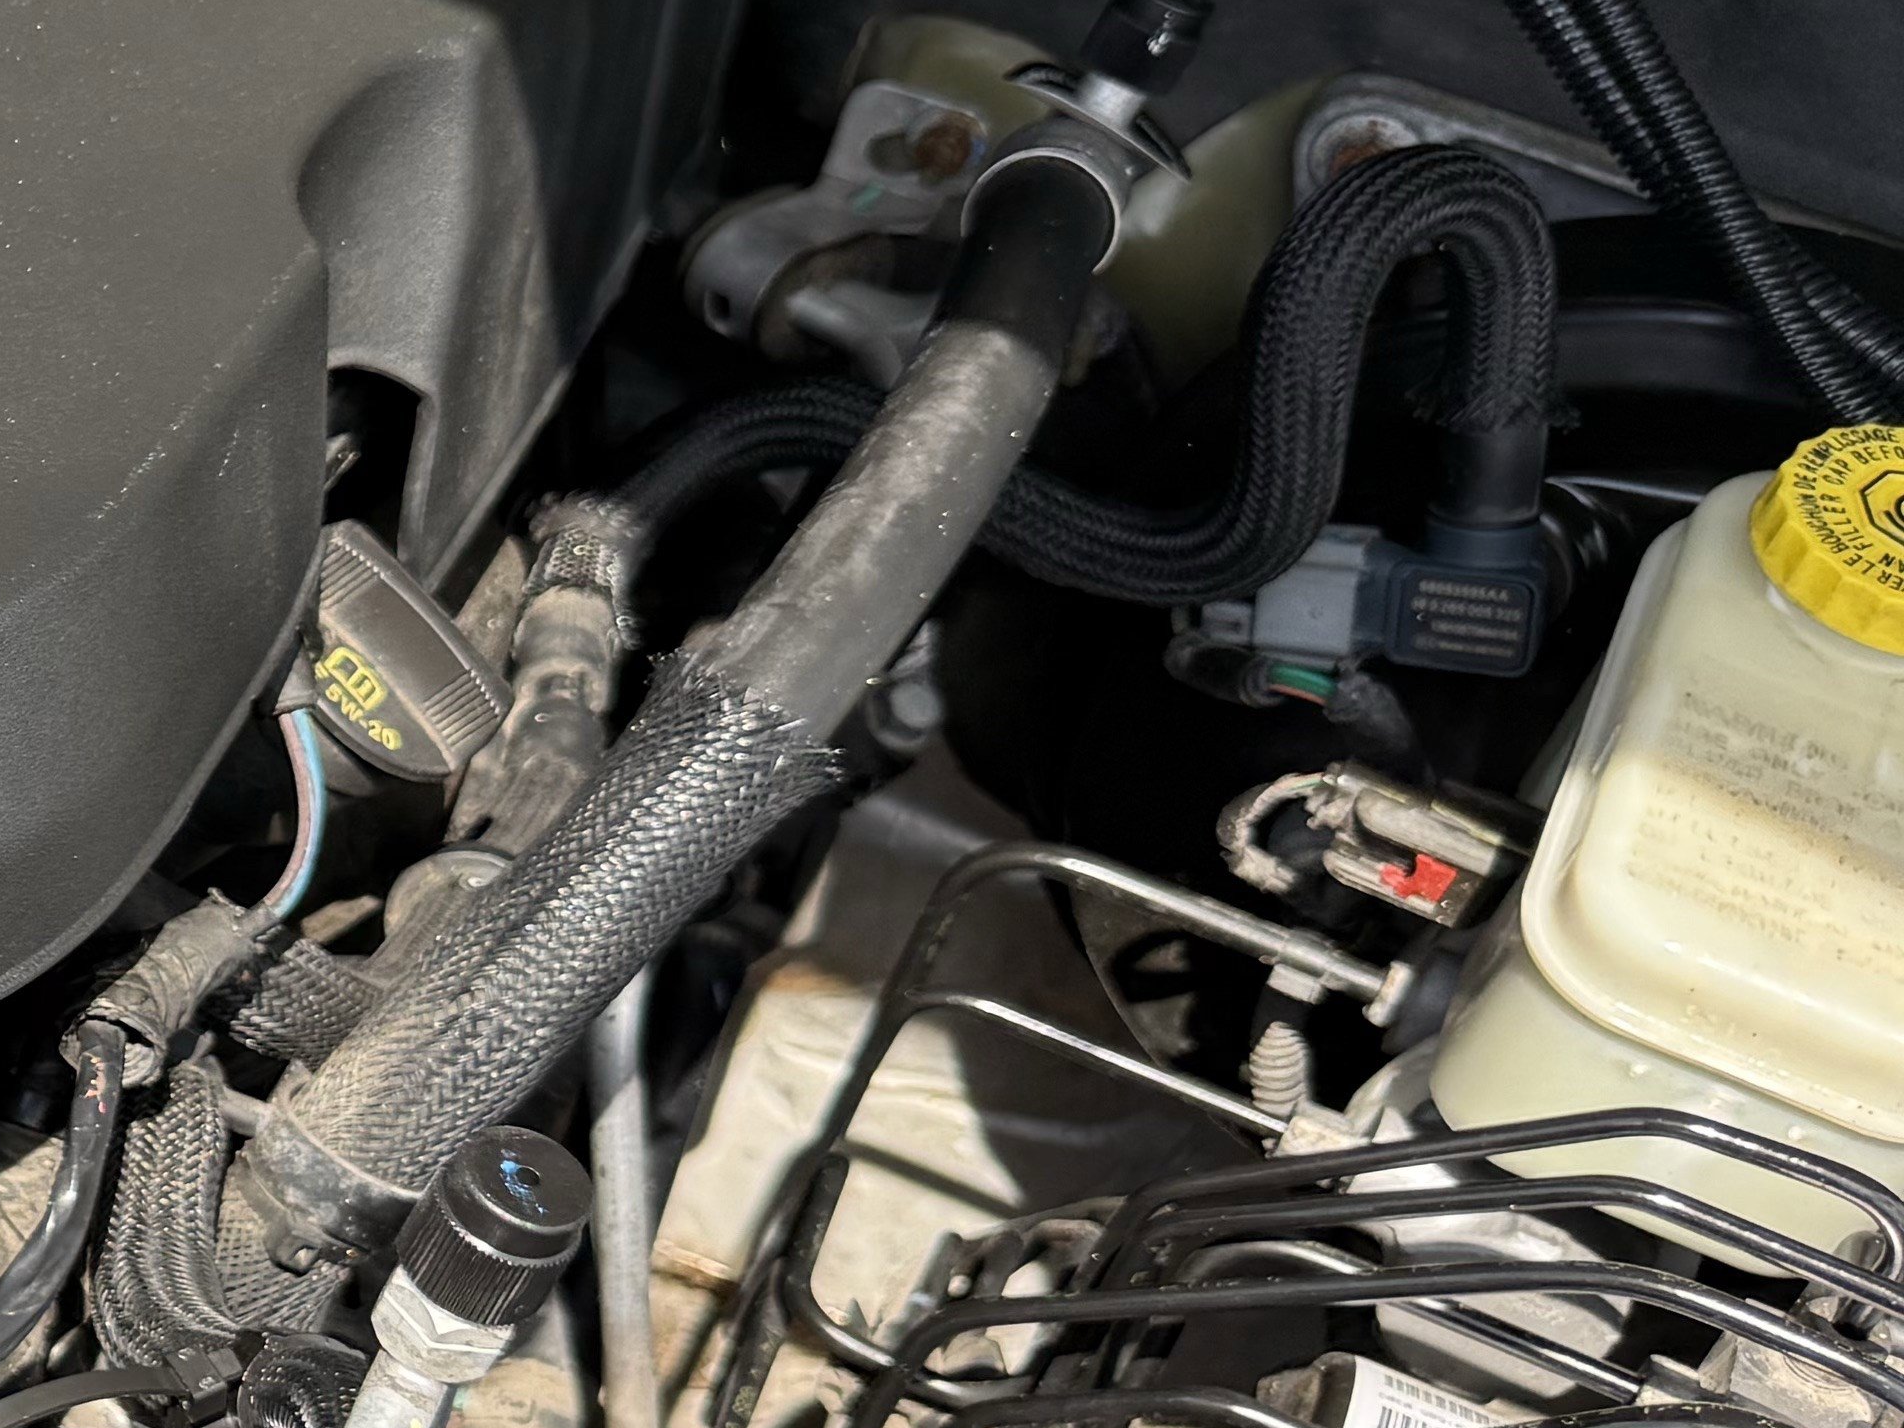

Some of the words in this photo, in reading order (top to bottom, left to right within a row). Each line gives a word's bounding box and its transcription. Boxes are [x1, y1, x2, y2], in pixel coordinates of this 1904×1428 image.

[1797, 427, 1900, 473] REMPLISSAGE
[1822, 458, 1853, 486] CAP
[1793, 472, 1818, 491] DE
[1796, 492, 1850, 555] BOUCHON
[1819, 493, 1874, 552] FILLER
[1842, 552, 1877, 575] LE
[324, 683, 403, 751] 5W-20
